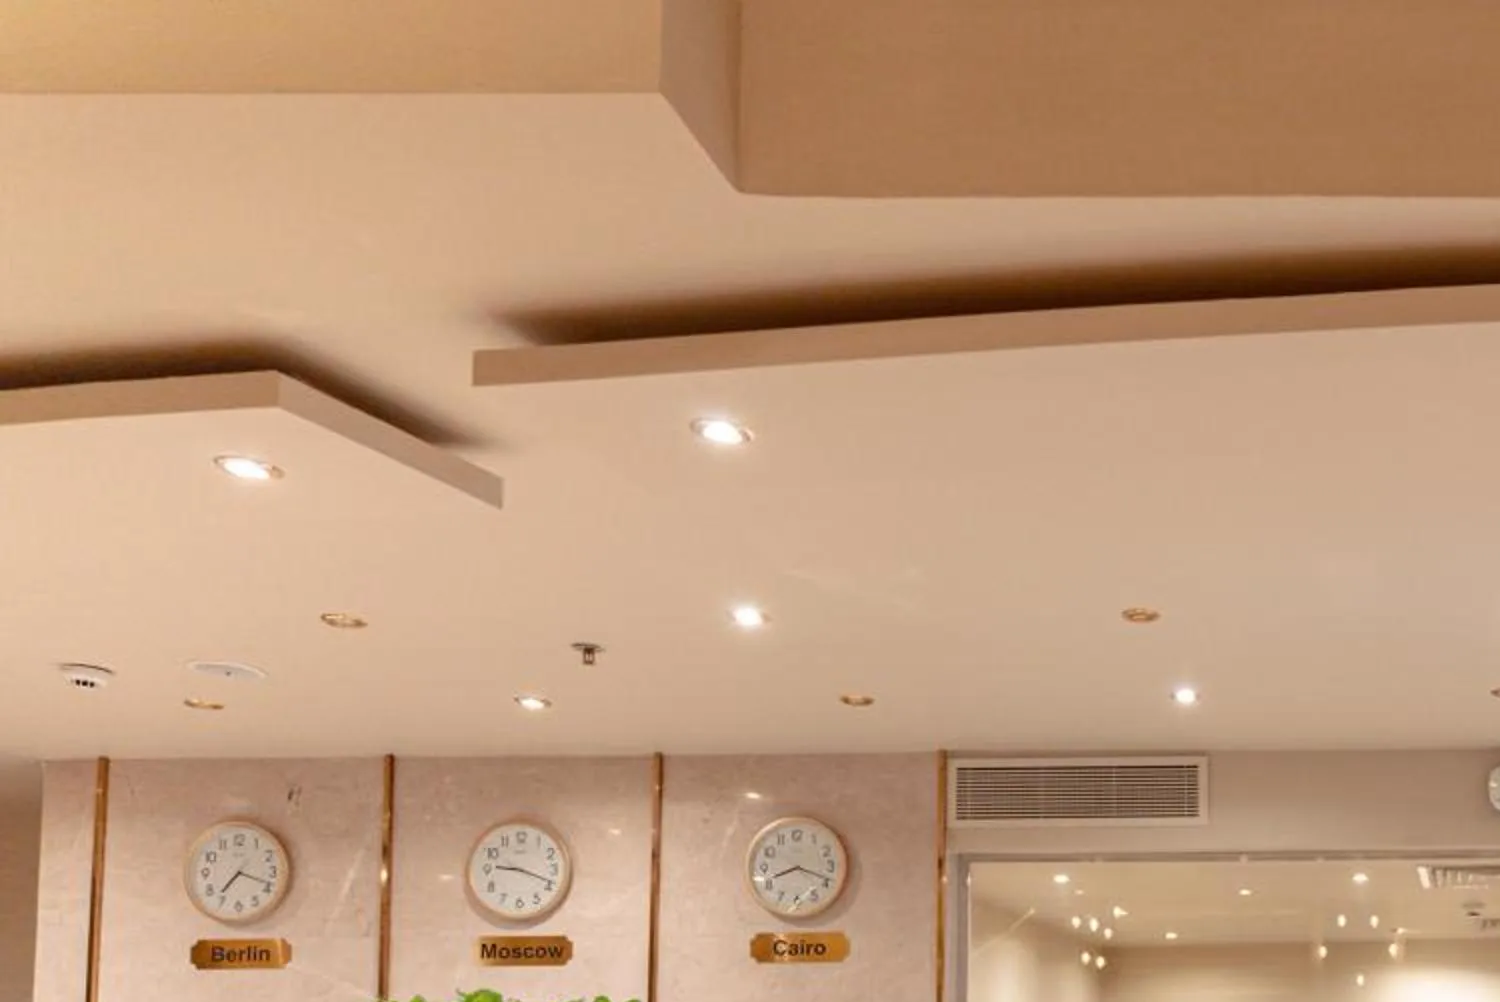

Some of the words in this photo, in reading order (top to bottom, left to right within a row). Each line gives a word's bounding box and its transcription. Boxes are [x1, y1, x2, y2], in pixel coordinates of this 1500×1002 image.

[211, 945, 272, 962] Berlin
[480, 943, 564, 960] Moscow
[773, 939, 827, 957] Cairo
